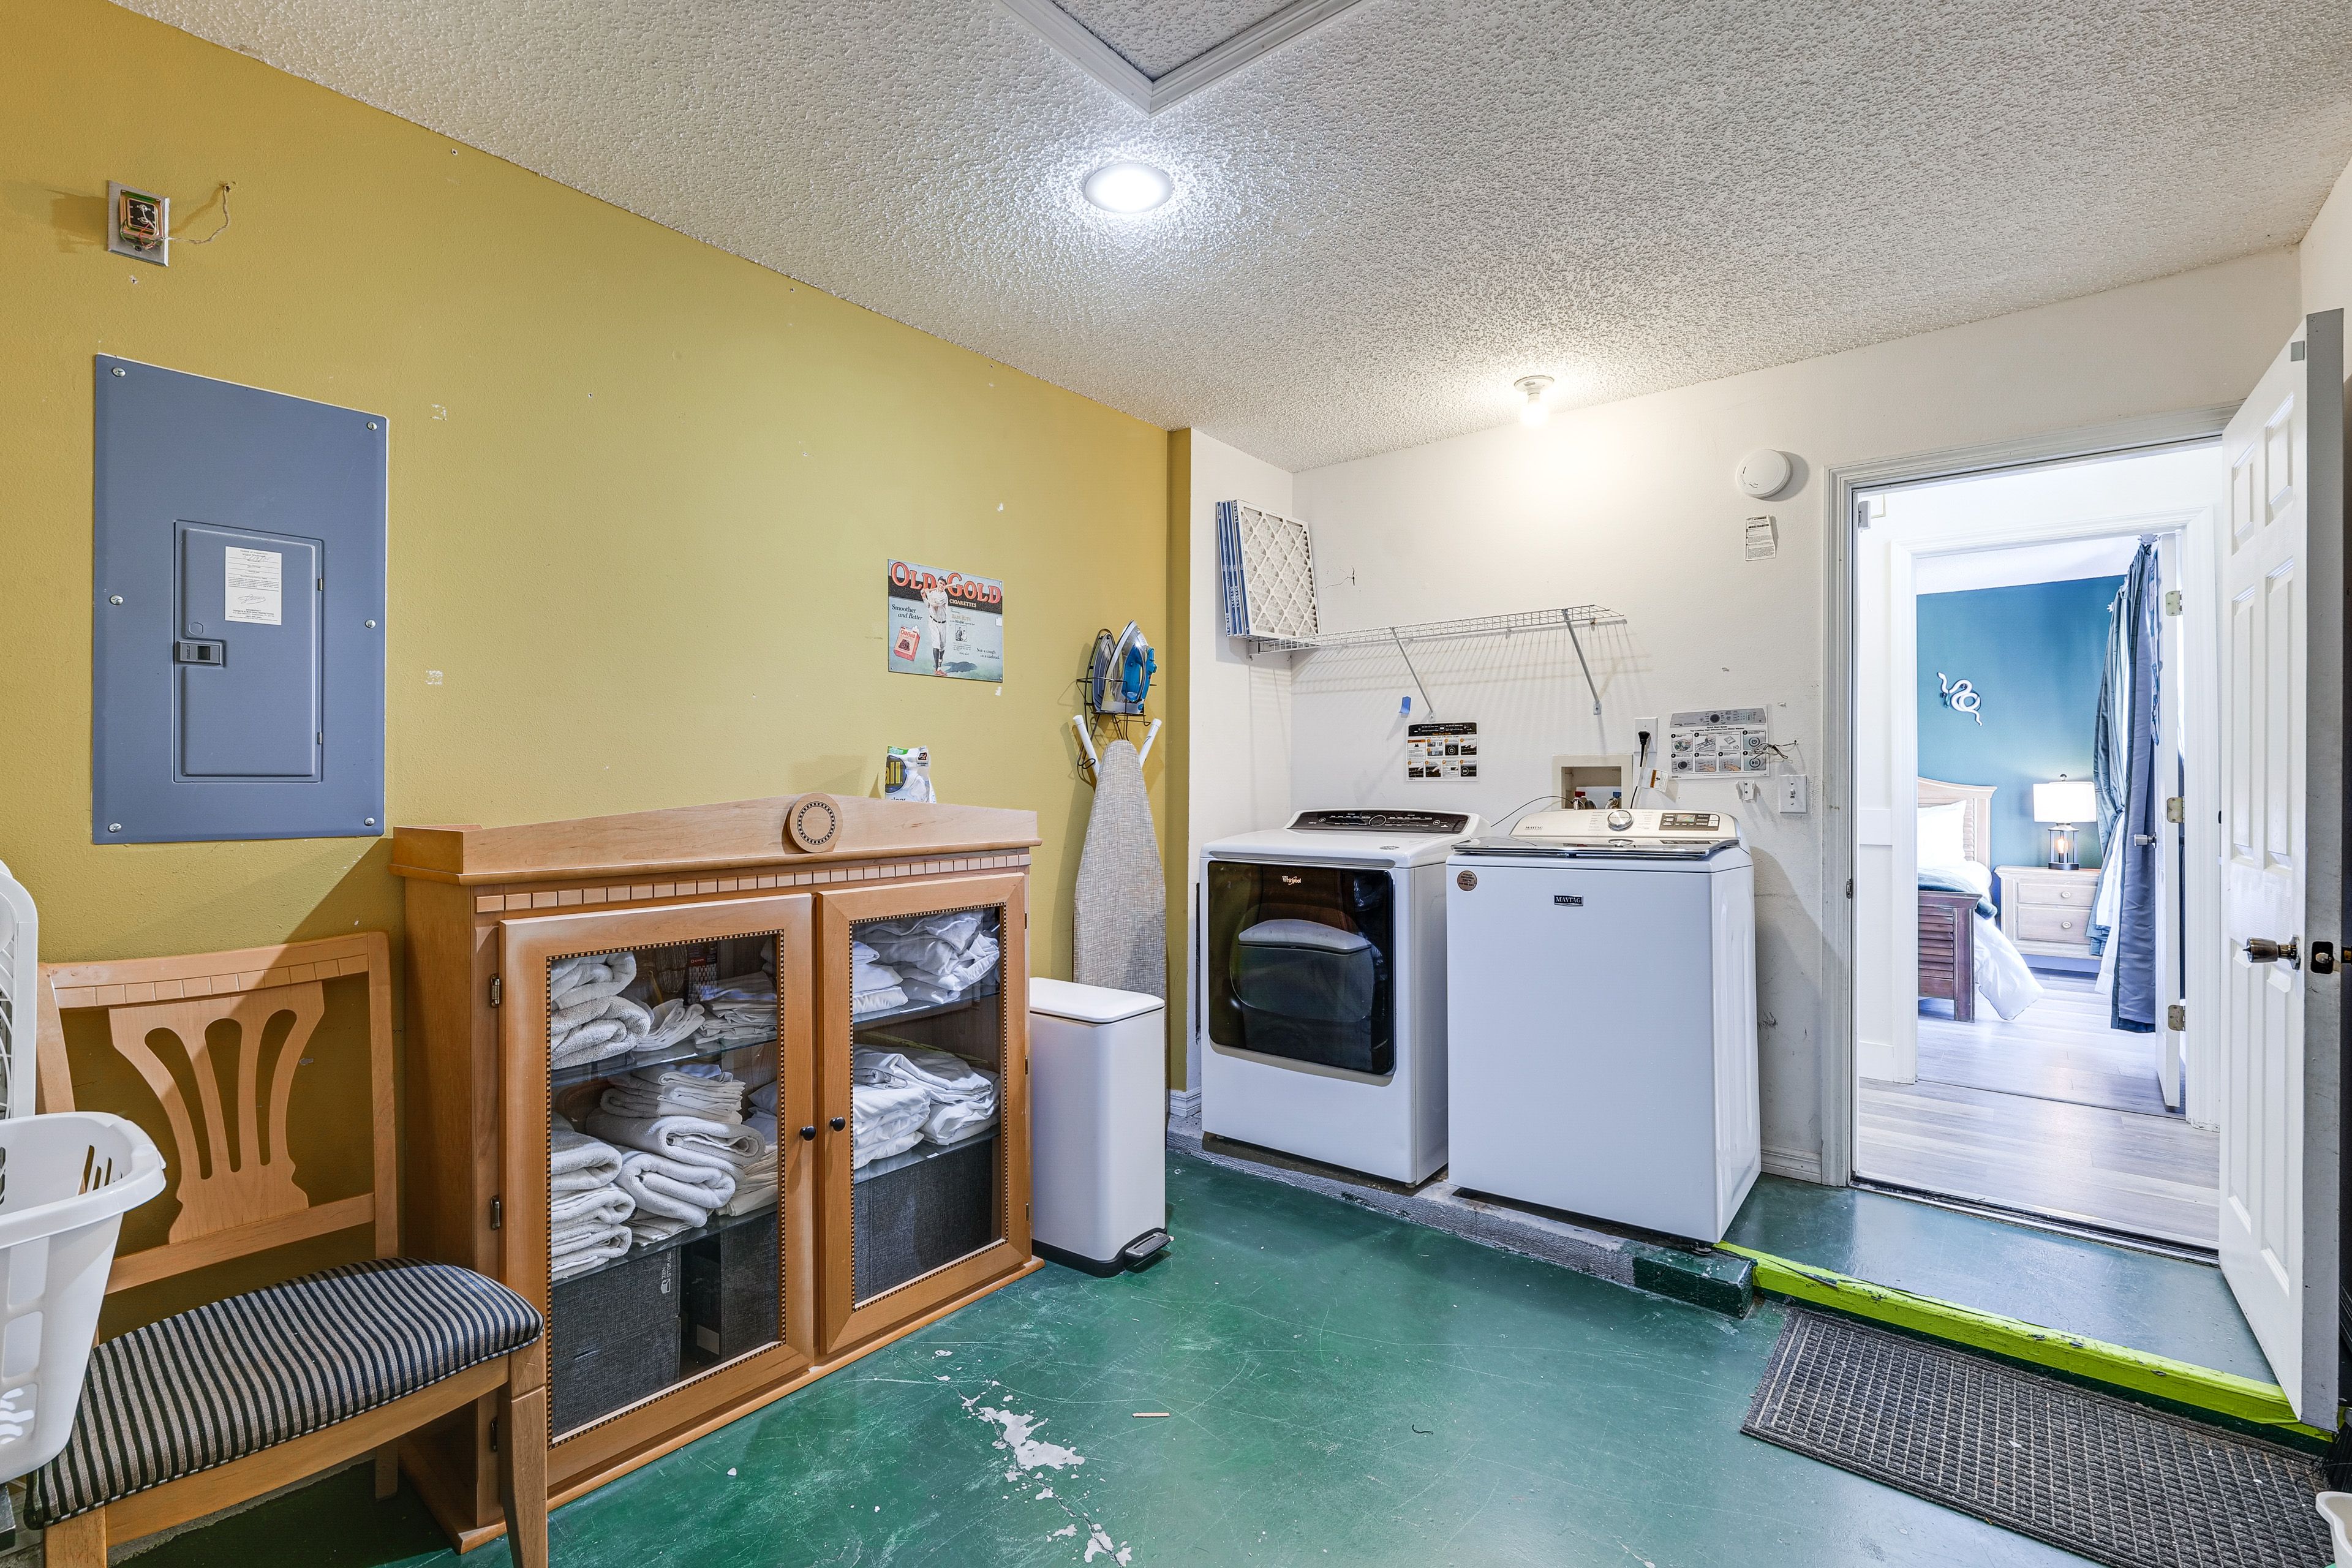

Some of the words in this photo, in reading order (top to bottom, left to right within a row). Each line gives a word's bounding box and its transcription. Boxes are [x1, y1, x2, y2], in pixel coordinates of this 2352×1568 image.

[891, 562, 937, 590] OLD
[947, 573, 1001, 604] GOLD
[949, 599, 977, 608] CIGARETTES
[892, 604, 916, 613] Smoother
[1282, 876, 1301, 885] Whirlpool
